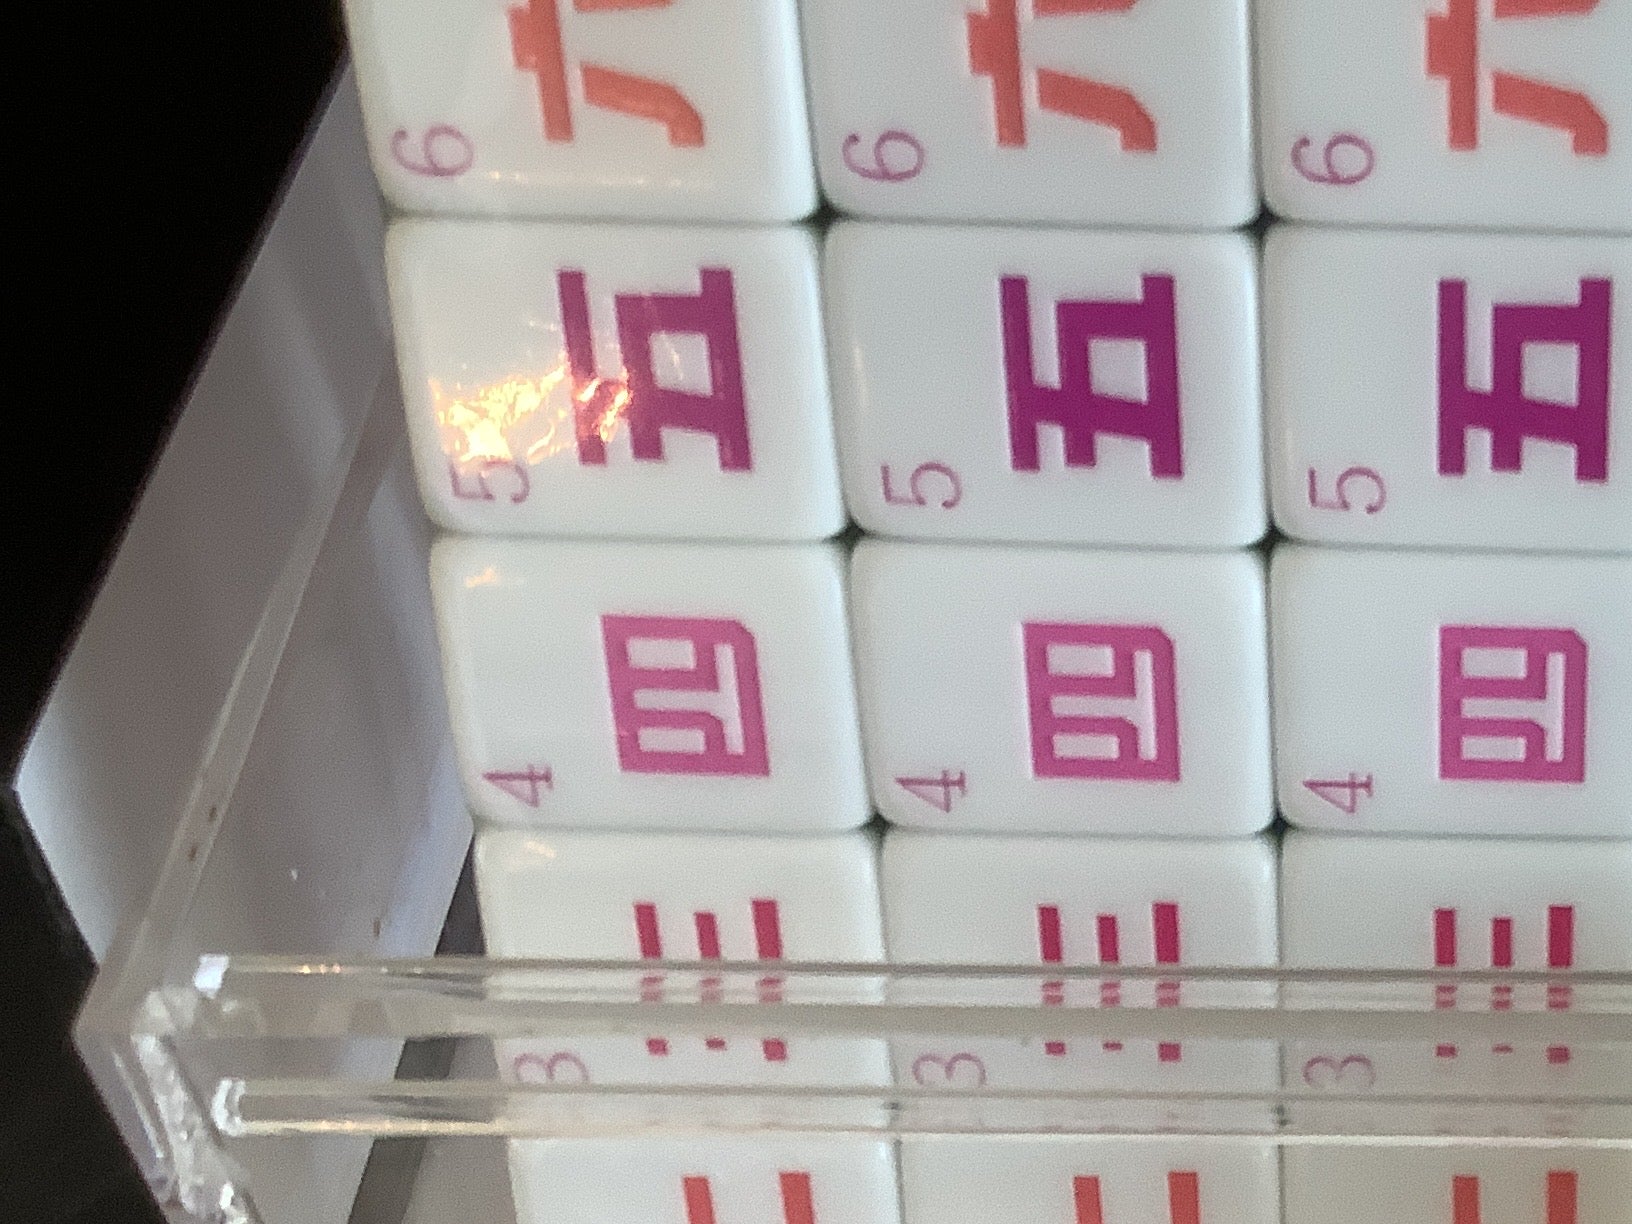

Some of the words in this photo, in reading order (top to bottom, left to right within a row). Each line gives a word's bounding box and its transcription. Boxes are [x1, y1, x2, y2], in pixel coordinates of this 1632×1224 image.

[391, 123, 475, 178] 6
[843, 129, 924, 183] 6
[1291, 133, 1374, 186] 6
[557, 267, 752, 471] 五
[999, 273, 1183, 480] 五
[1438, 278, 1612, 483] 五
[449, 455, 531, 504] 5
[881, 461, 962, 510] 5
[1307, 466, 1387, 515] 5
[601, 613, 770, 777] 四
[1022, 621, 1182, 783] 四
[1438, 624, 1588, 783] 四
[482, 763, 553, 808] 4
[895, 768, 966, 813] 4
[1303, 772, 1373, 814] 4
[912, 1052, 987, 1087] 3
[1303, 1054, 1377, 1090] 3
